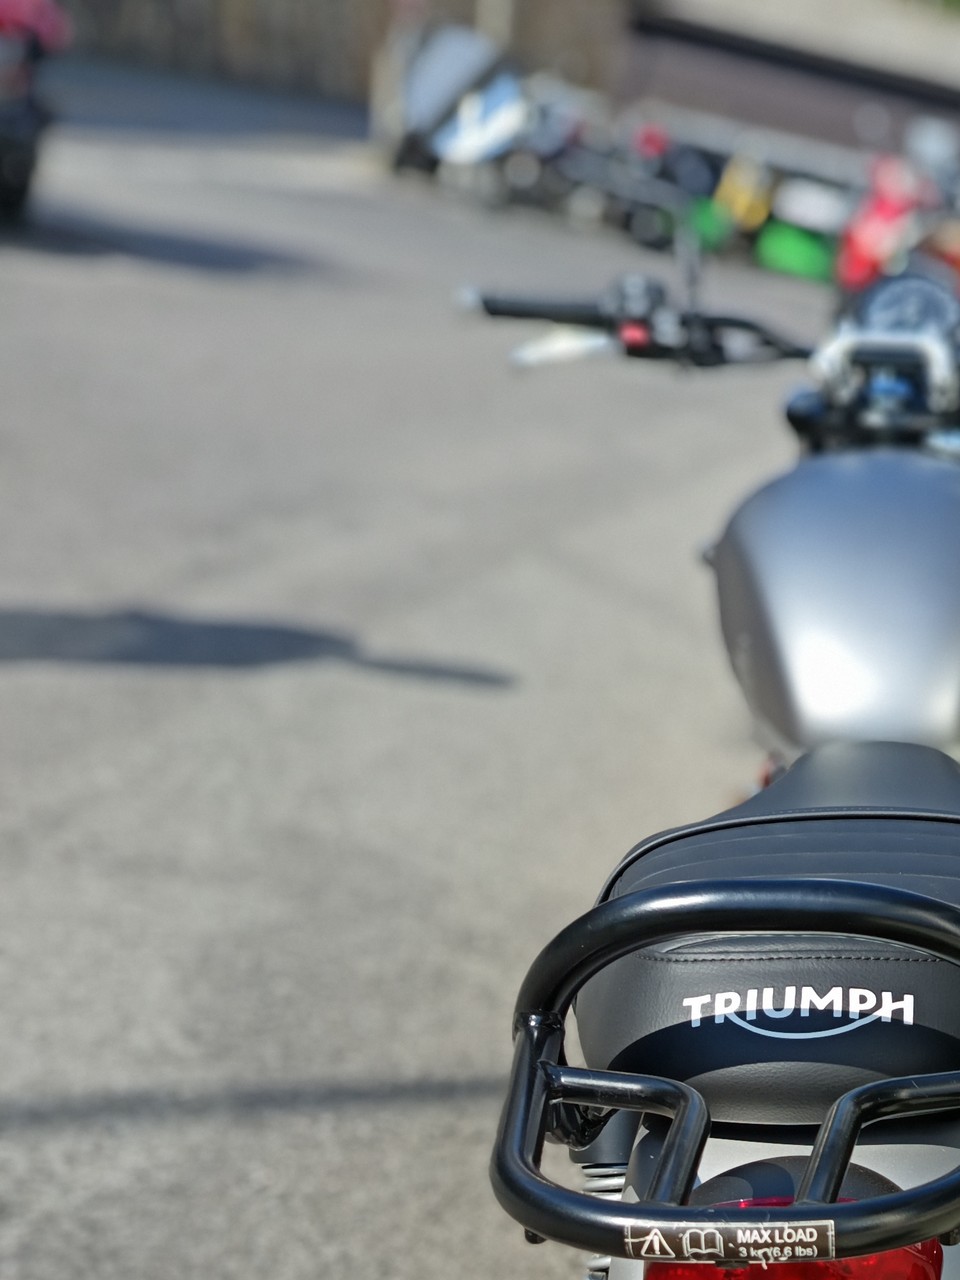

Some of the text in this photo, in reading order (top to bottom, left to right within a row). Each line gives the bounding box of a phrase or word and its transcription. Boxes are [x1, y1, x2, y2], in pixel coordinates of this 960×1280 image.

[682, 985, 915, 1039] TRIUMPH
[736, 1227, 818, 1244] MAX LOAD
[738, 1246, 748, 1258] 3
[795, 1244, 818, 1258] lbs)
